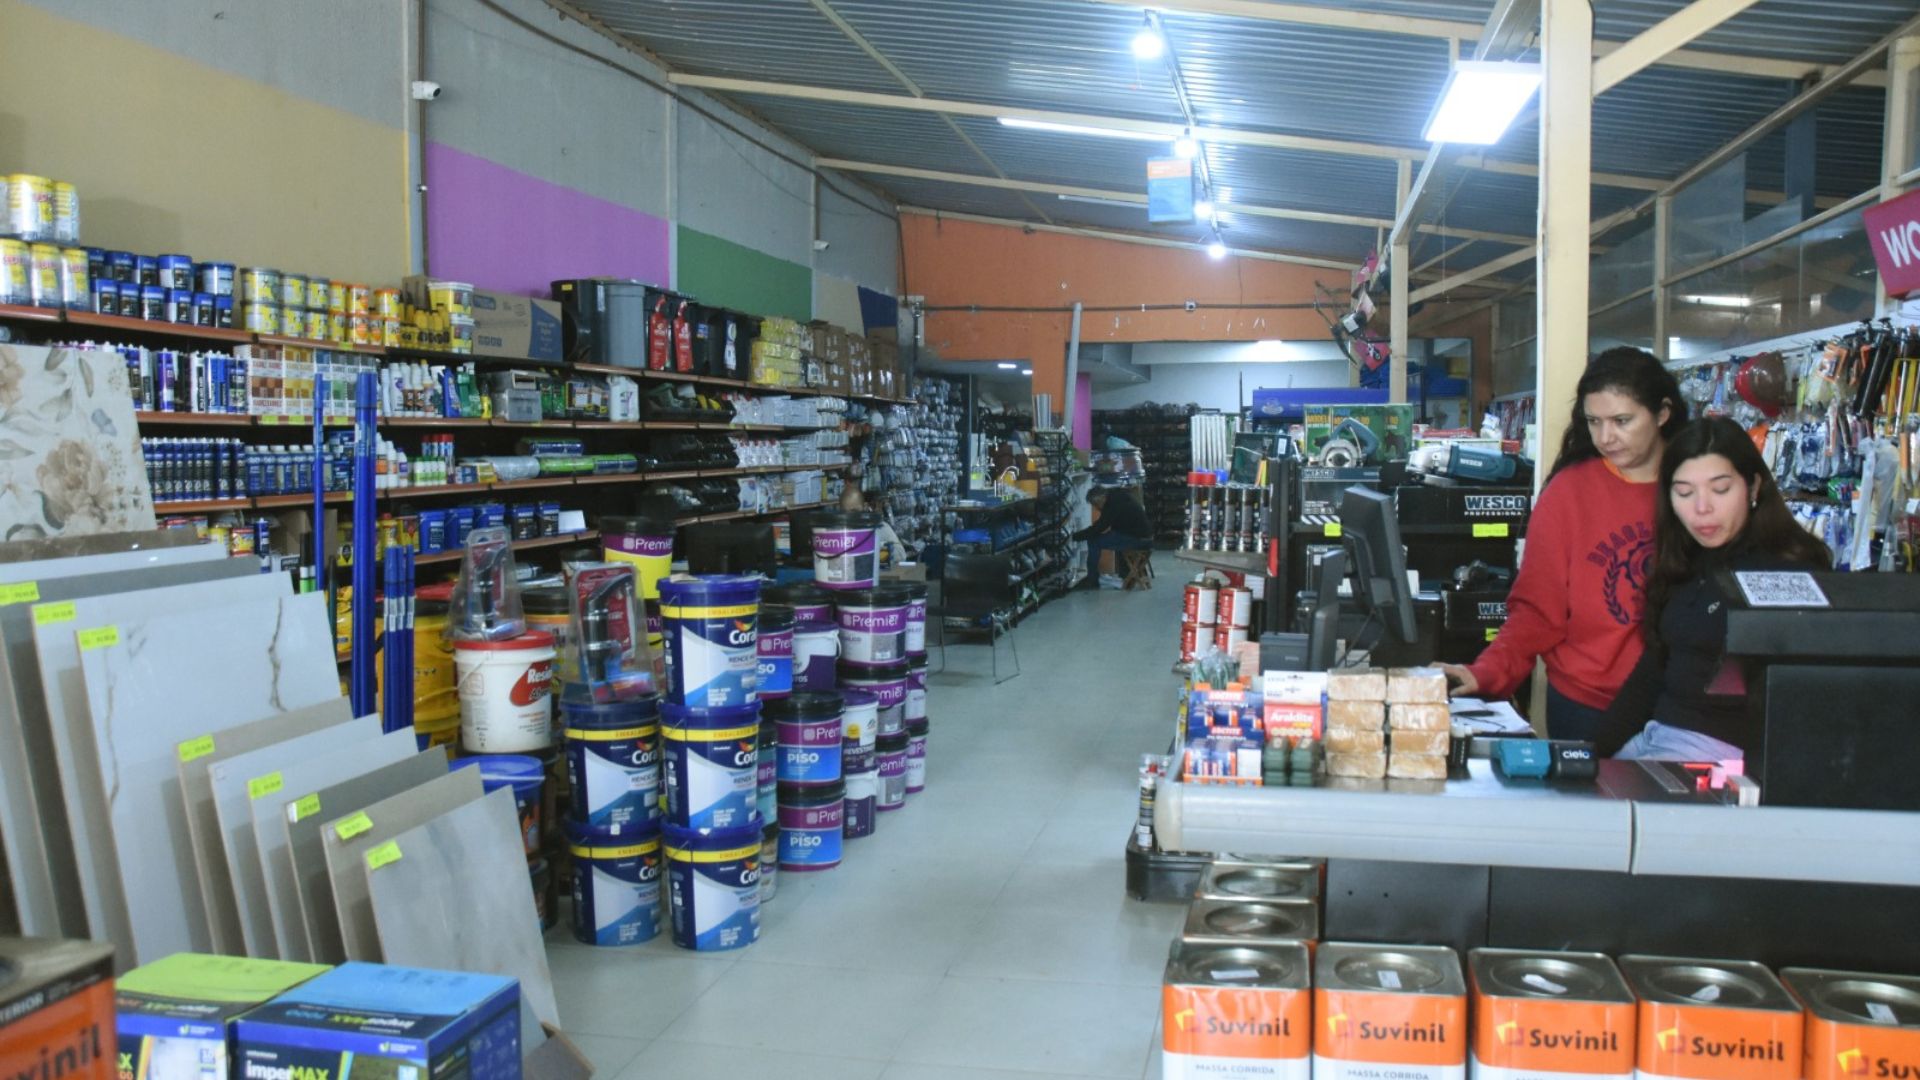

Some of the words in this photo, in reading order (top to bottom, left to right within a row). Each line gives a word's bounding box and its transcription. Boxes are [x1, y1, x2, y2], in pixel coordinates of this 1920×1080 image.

[1464, 495, 1527, 511] WESCO
[787, 752, 820, 764] PISO
[1562, 750, 1591, 760] cielo
[790, 836, 822, 848] PISO
[1206, 1015, 1291, 1038] Suvinil
[1359, 1020, 1446, 1043] Suvinil
[1529, 1028, 1618, 1052] Suvinil
[1691, 1035, 1785, 1062] Suvinil
[1195, 1063, 1228, 1074] MASSA
[1230, 1064, 1275, 1075] CORRIDA
[1347, 1067, 1387, 1079] MASSA
